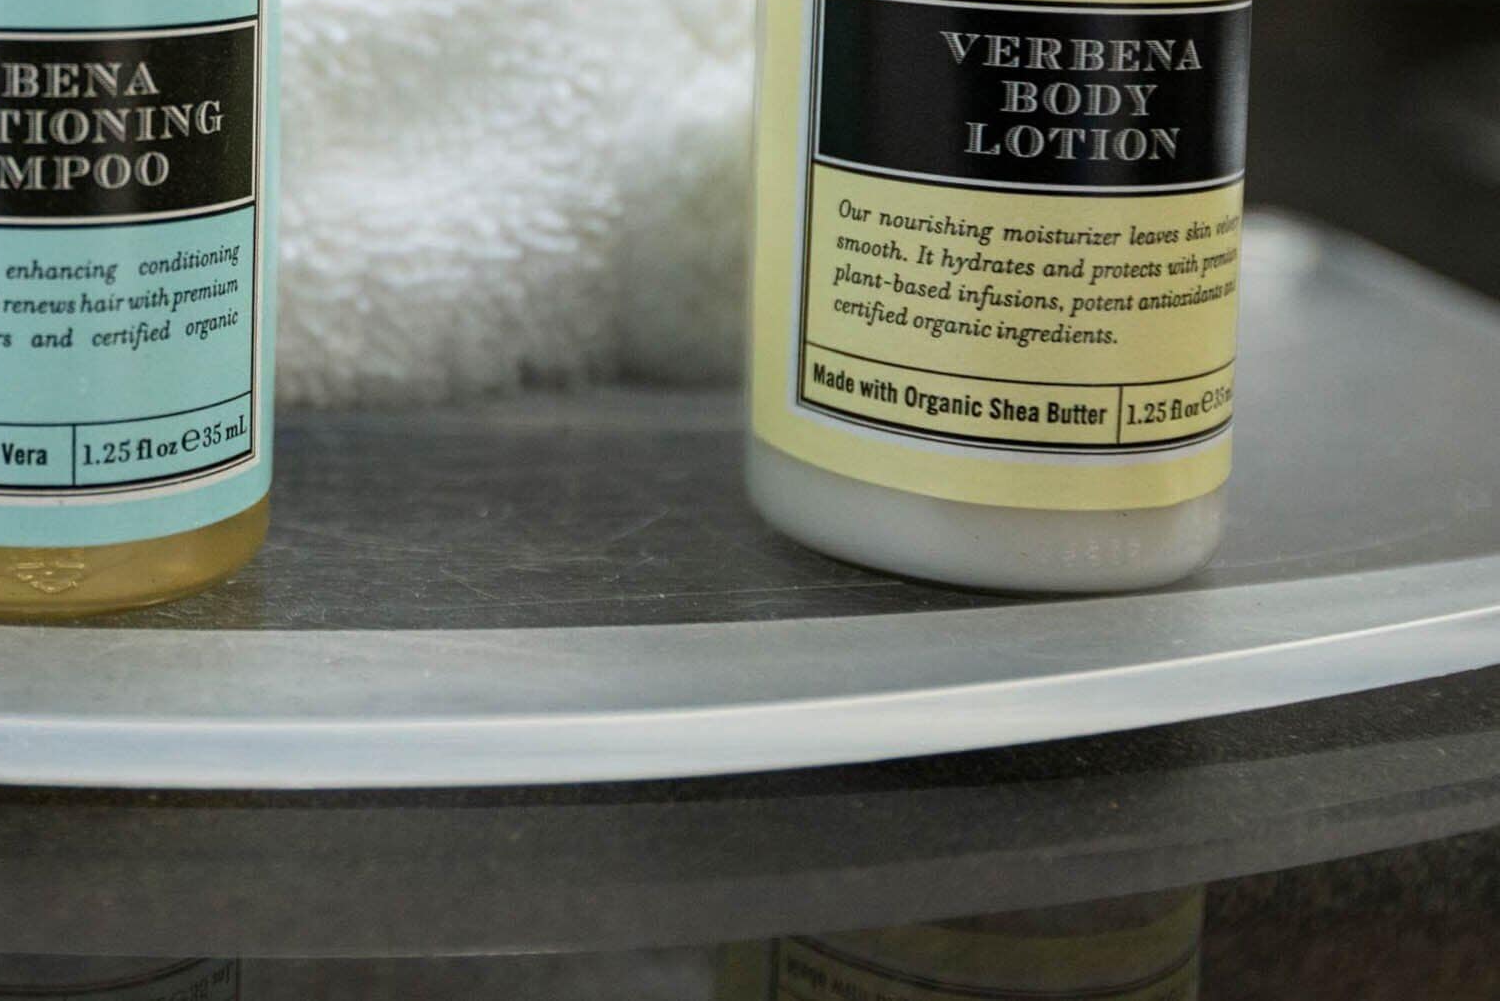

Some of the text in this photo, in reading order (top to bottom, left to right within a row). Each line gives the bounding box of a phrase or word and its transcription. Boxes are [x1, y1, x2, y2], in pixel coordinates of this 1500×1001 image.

[940, 31, 1203, 72] VERBENA
[1001, 80, 1159, 117] BODY
[964, 121, 1181, 161] LOTION
[839, 199, 871, 223] Our
[879, 210, 995, 246] nourishing
[1003, 225, 1121, 246] moisturizer
[1129, 226, 1179, 246] leaves
[1186, 221, 1211, 241] skin
[6, 260, 118, 285] enhancing
[138, 244, 240, 277] conditioning
[836, 234, 908, 262] smooth.
[916, 245, 934, 265] It
[941, 249, 1035, 276] hydrates
[1043, 259, 1084, 278] and
[1089, 258, 1162, 286] protects
[1168, 253, 1198, 276] with
[3, 300, 76, 315] renews
[80, 293, 124, 314] hair
[129, 287, 169, 311] with
[171, 278, 239, 313] premium
[833, 263, 952, 300] plant-based
[958, 284, 1064, 312] infusions,
[1070, 294, 1133, 318] potent
[1138, 284, 1223, 311] antioxidants
[31, 328, 73, 348] and
[92, 320, 171, 350] certified
[185, 307, 239, 340] organic
[834, 297, 1118, 347] certified organic ingredients.
[814, 362, 1108, 425] Made with Organic Shea Butter
[1126, 401, 1167, 425] 1.25
[1, 443, 48, 466] Vera
[82, 439, 131, 466] 1.25
